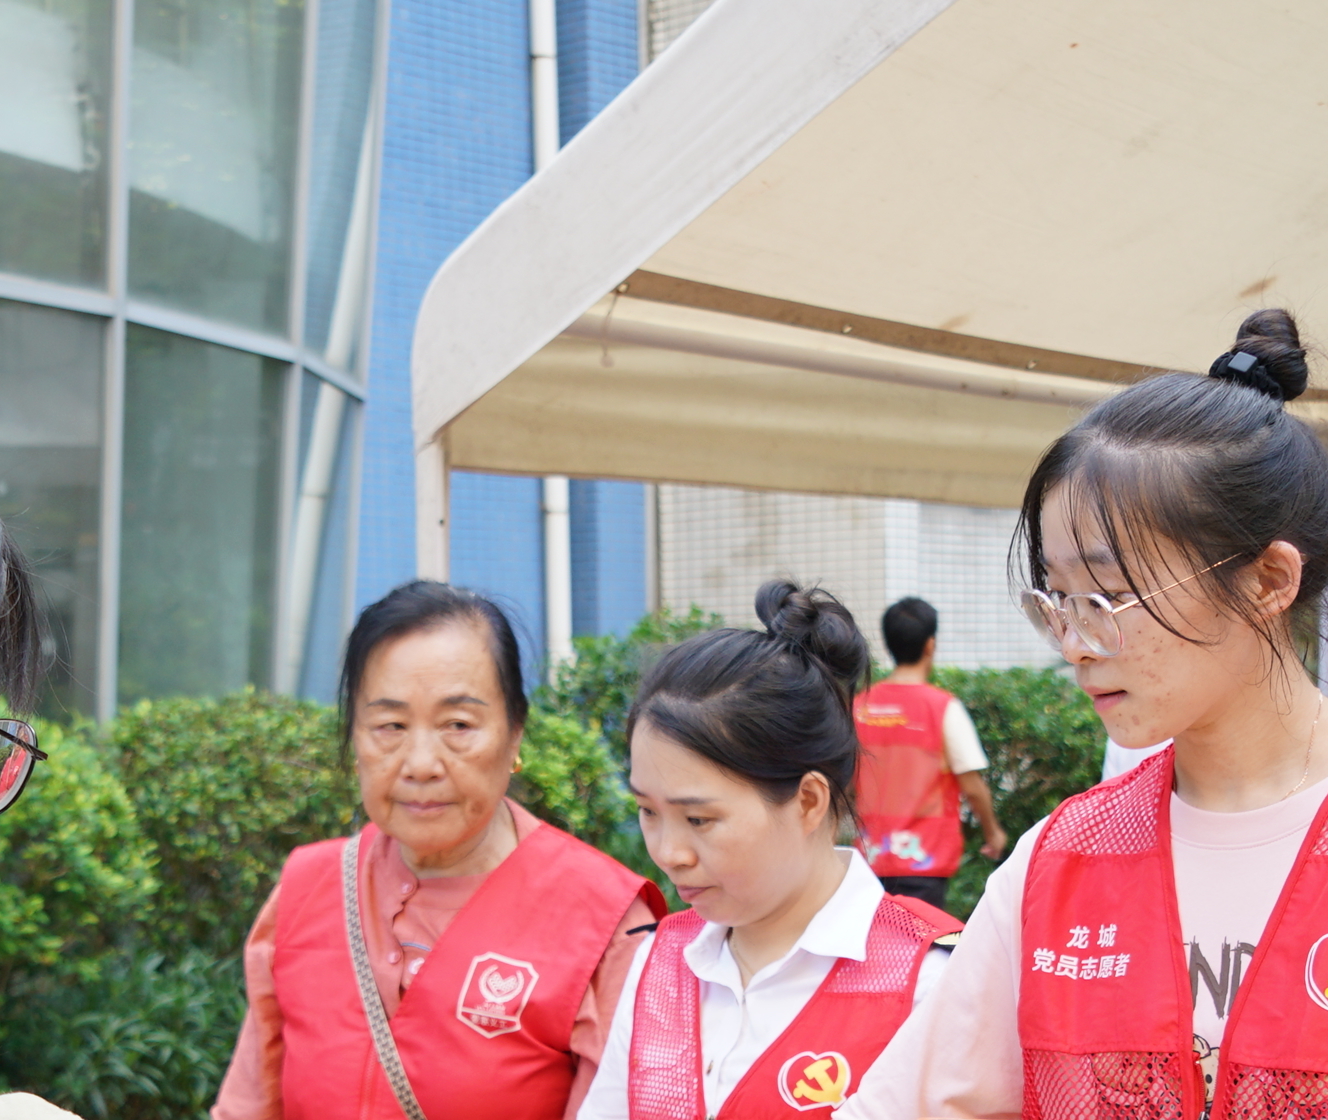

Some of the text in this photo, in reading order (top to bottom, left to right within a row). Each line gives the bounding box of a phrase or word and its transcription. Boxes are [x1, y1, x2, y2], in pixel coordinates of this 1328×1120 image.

[1066, 923, 1118, 949] 龙城
[1031, 947, 1131, 980] 党员志愿者
